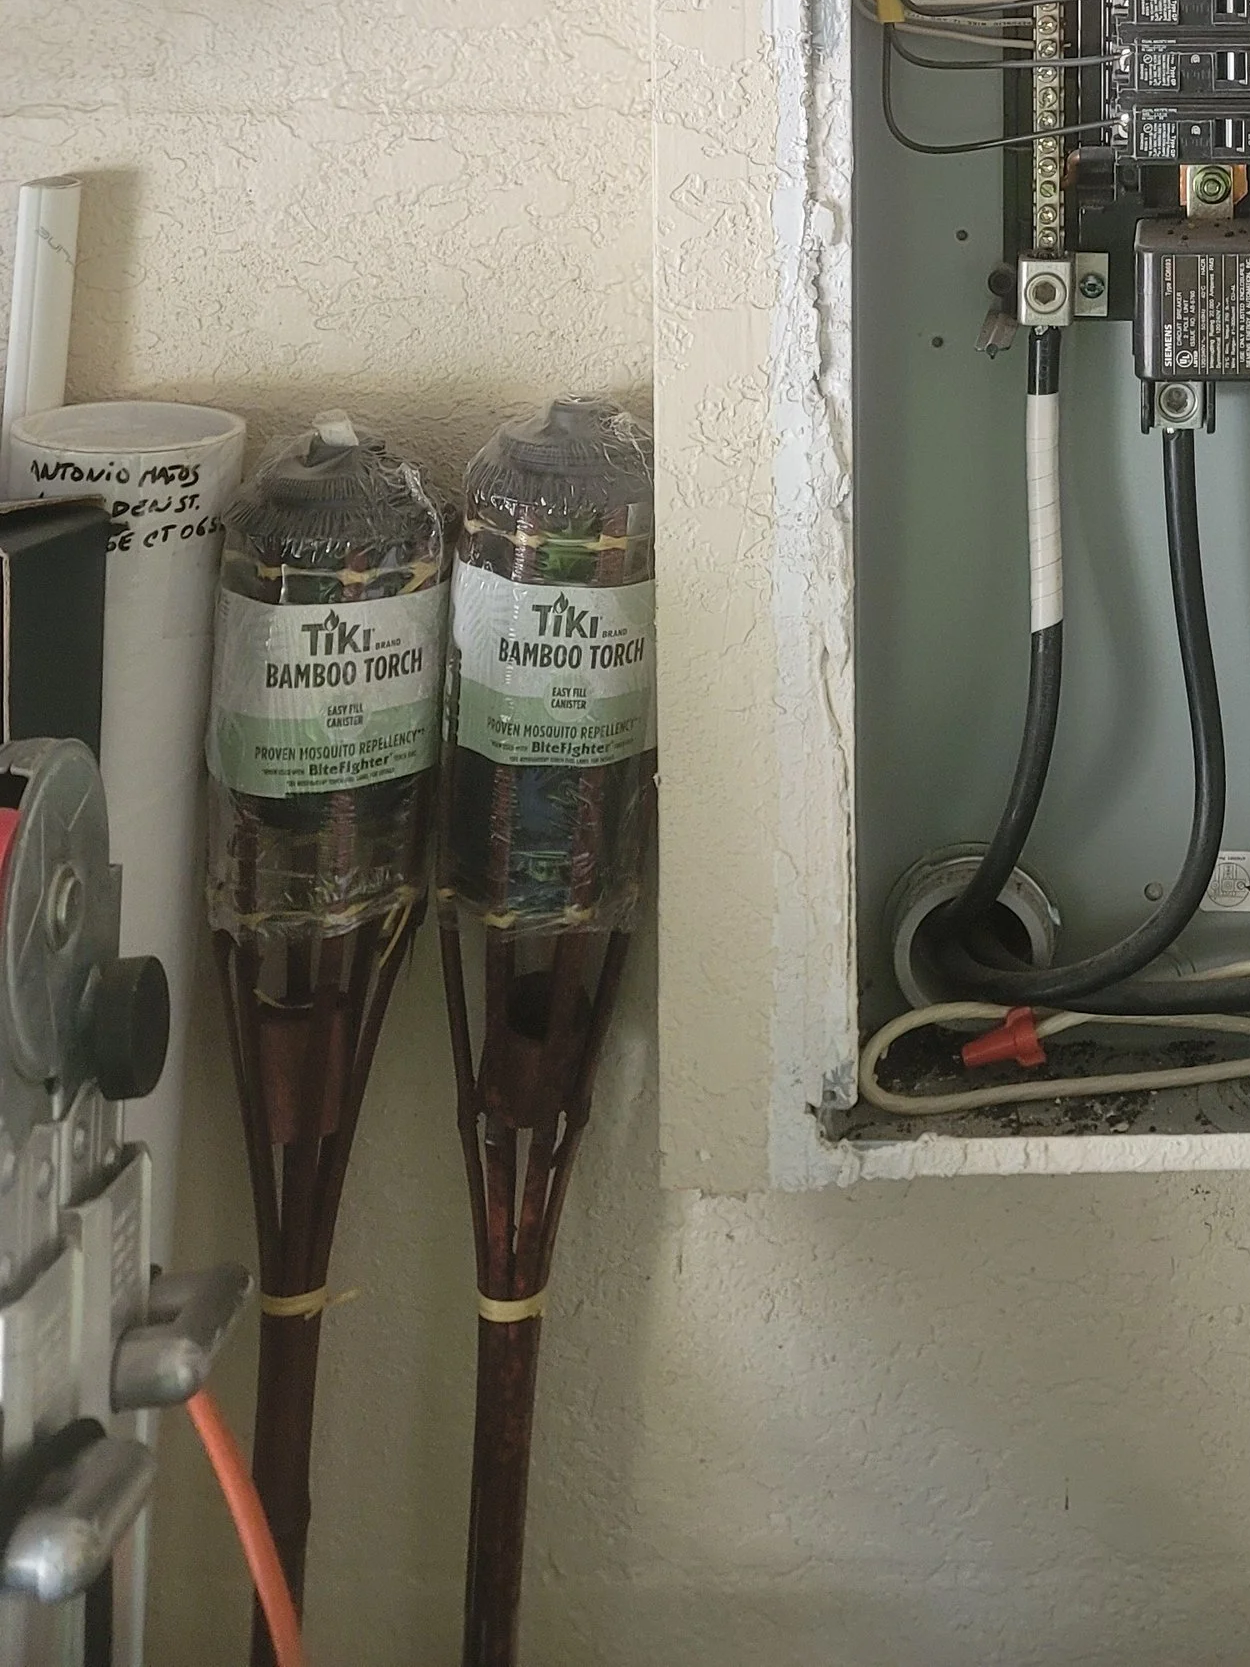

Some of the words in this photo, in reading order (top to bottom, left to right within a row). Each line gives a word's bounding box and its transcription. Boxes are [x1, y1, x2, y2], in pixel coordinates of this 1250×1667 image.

[1165, 283, 1173, 296] Type
[1164, 324, 1172, 367] SIEMENS
[602, 628, 627, 638] BRAND
[375, 638, 401, 650] BRAND
[499, 638, 582, 669] BAMBOO
[590, 638, 645, 669] TORCH
[266, 660, 357, 689] BAMBOO
[364, 648, 423, 683] TORCH
[552, 687, 571, 698] EASY
[573, 687, 586, 697] FILL
[328, 705, 348, 716] EASY
[349, 703, 363, 714] FILL
[551, 698, 586, 709] CANISTER
[327, 715, 363, 728] CANISTER
[487, 717, 521, 736] PROVEN
[523, 725, 577, 738] MOSQUITO
[255, 746, 296, 761] PROVEN
[299, 742, 355, 761] MOSQUITO
